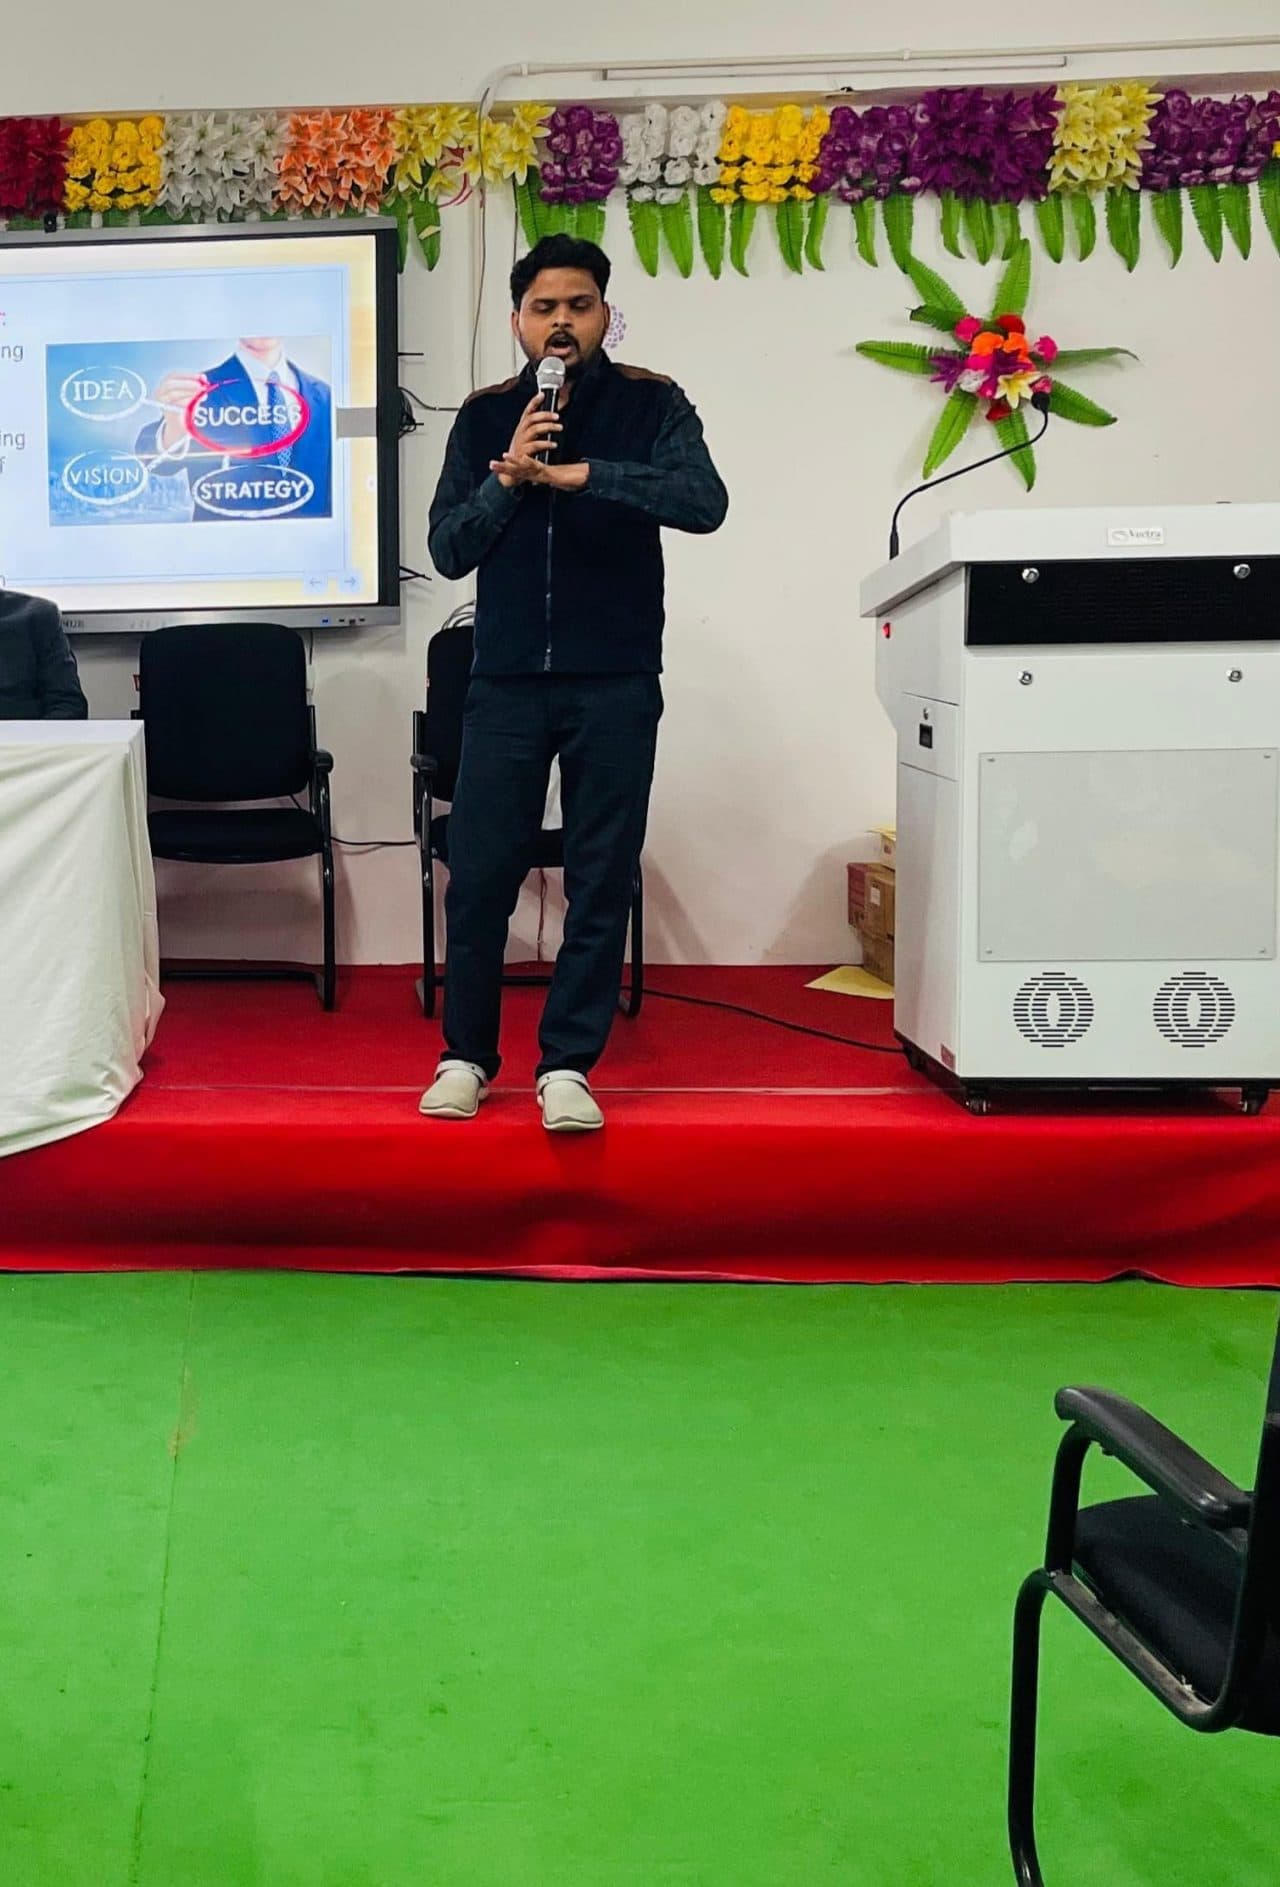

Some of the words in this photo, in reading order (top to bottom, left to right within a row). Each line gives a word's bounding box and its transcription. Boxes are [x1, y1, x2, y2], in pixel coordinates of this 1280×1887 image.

[73, 379, 135, 401] IDEA
[192, 404, 302, 428] SUCCESS
[69, 466, 140, 486] VISION
[200, 479, 307, 501] STRATEGY
